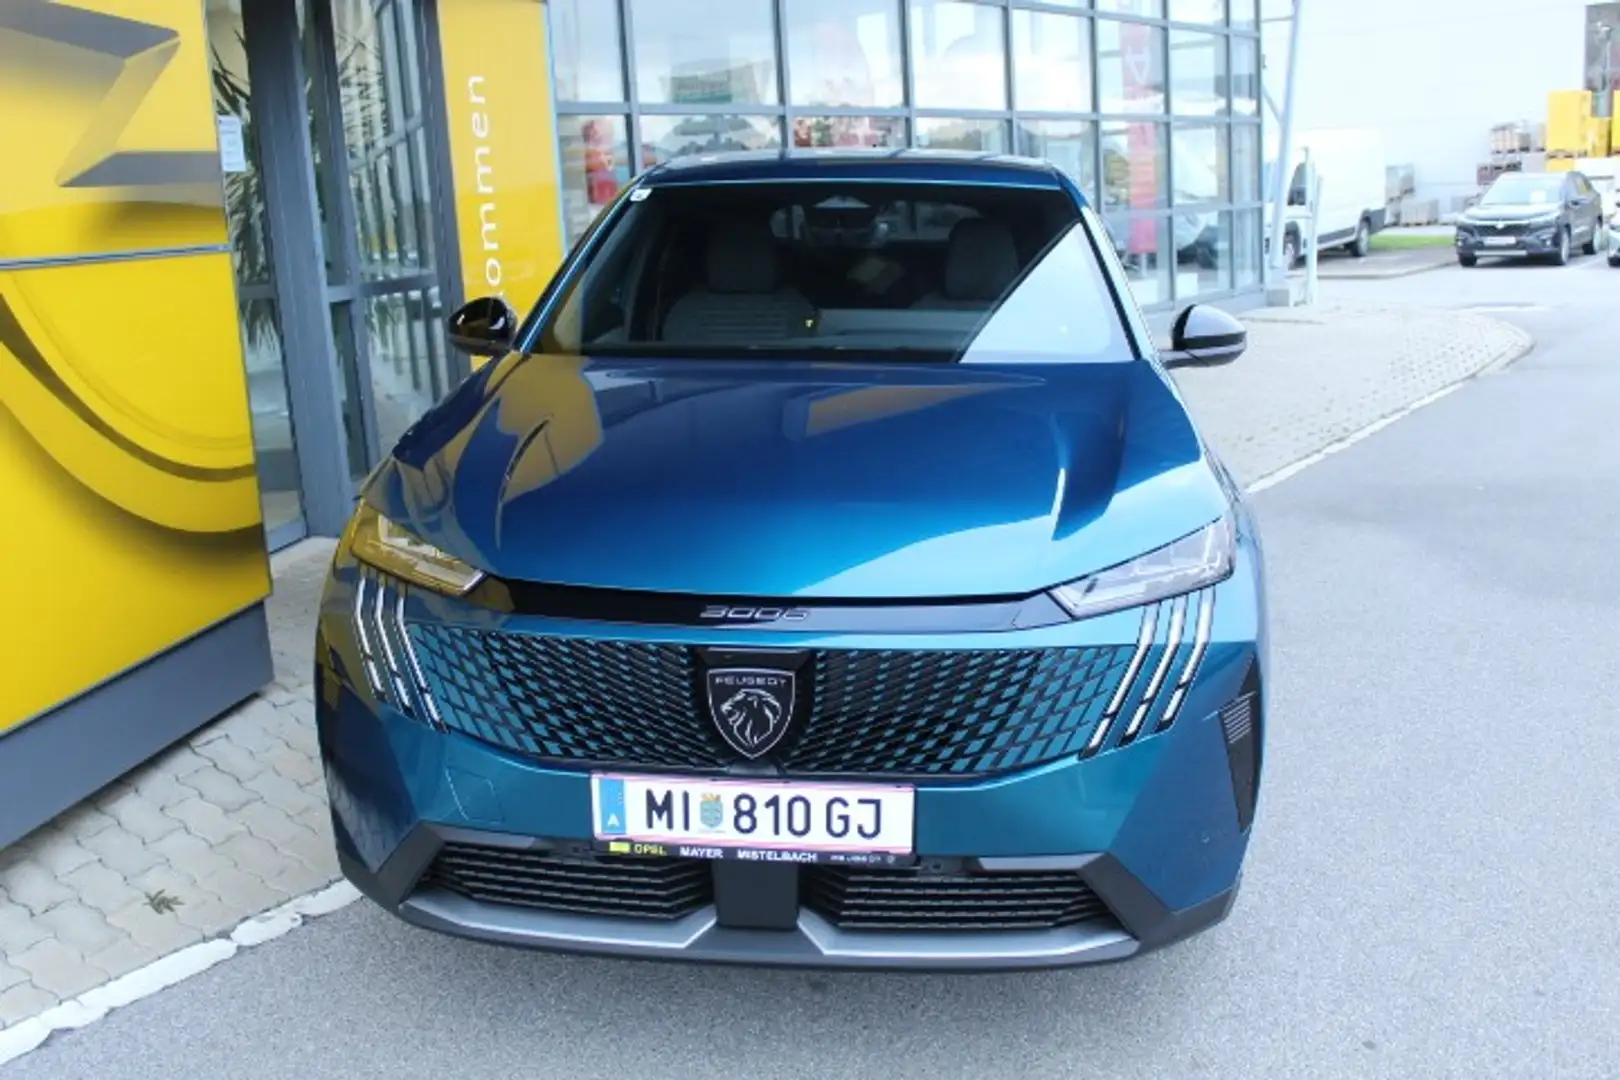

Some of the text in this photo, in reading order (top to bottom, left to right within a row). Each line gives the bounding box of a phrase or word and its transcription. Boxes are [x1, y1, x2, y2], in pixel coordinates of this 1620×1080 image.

[468, 75, 503, 297] ommen
[715, 676, 787, 686] PEUGEOT
[607, 814, 620, 828] A
[645, 788, 882, 840] MI 810 GJ
[633, 844, 668, 857] OPEL
[680, 846, 723, 859] MAYER
[737, 850, 817, 863] MISTELBACH
